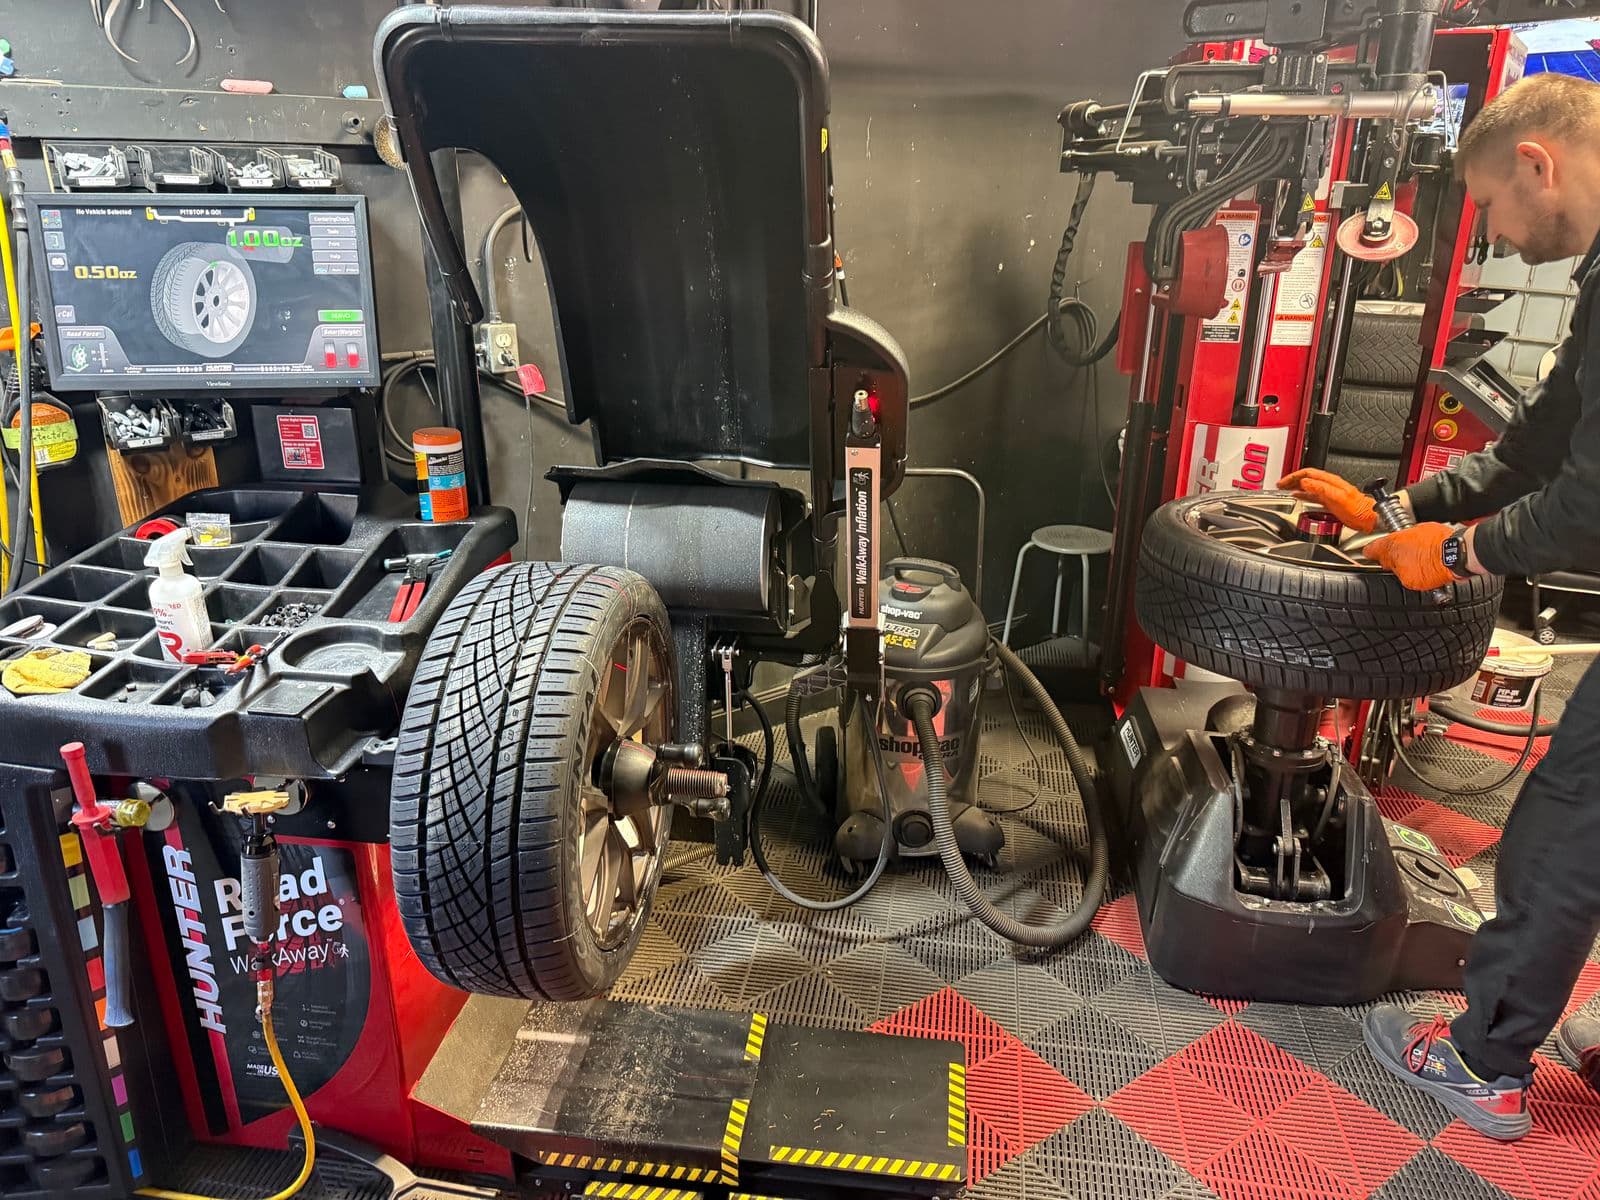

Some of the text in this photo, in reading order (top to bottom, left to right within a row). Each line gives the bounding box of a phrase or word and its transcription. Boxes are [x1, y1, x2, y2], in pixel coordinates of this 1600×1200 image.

[74, 265, 137, 279] 0.50oz
[855, 490, 867, 533] Inflation
[855, 535, 870, 585] WalkAway
[213, 856, 328, 915] Rad
[162, 844, 227, 1034] HUNTER
[221, 904, 344, 952] Frce
[264, 1065, 280, 1076] US
